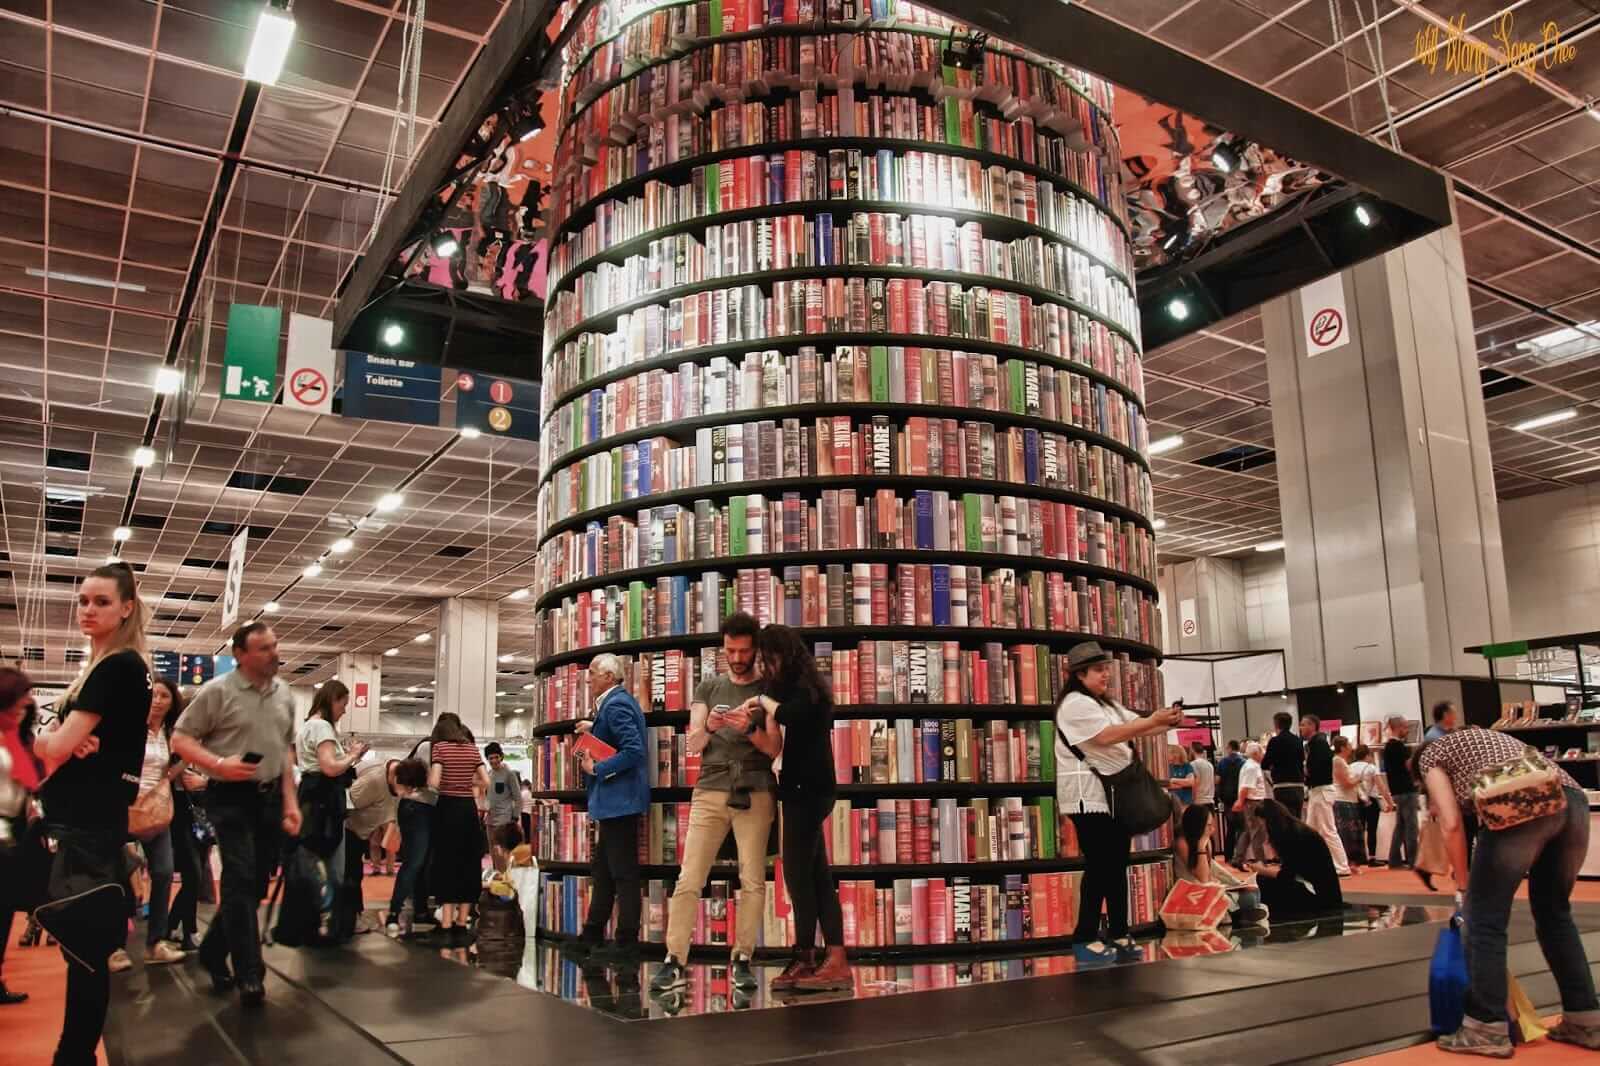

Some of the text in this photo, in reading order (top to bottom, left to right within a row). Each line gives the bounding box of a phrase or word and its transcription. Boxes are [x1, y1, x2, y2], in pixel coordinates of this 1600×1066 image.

[1025, 368, 1040, 408] MARE
[873, 426, 890, 468] MARE
[1044, 439, 1058, 480] MARE
[652, 659, 665, 702] MARE
[910, 648, 927, 694] MARE
[954, 886, 971, 932] MARE
